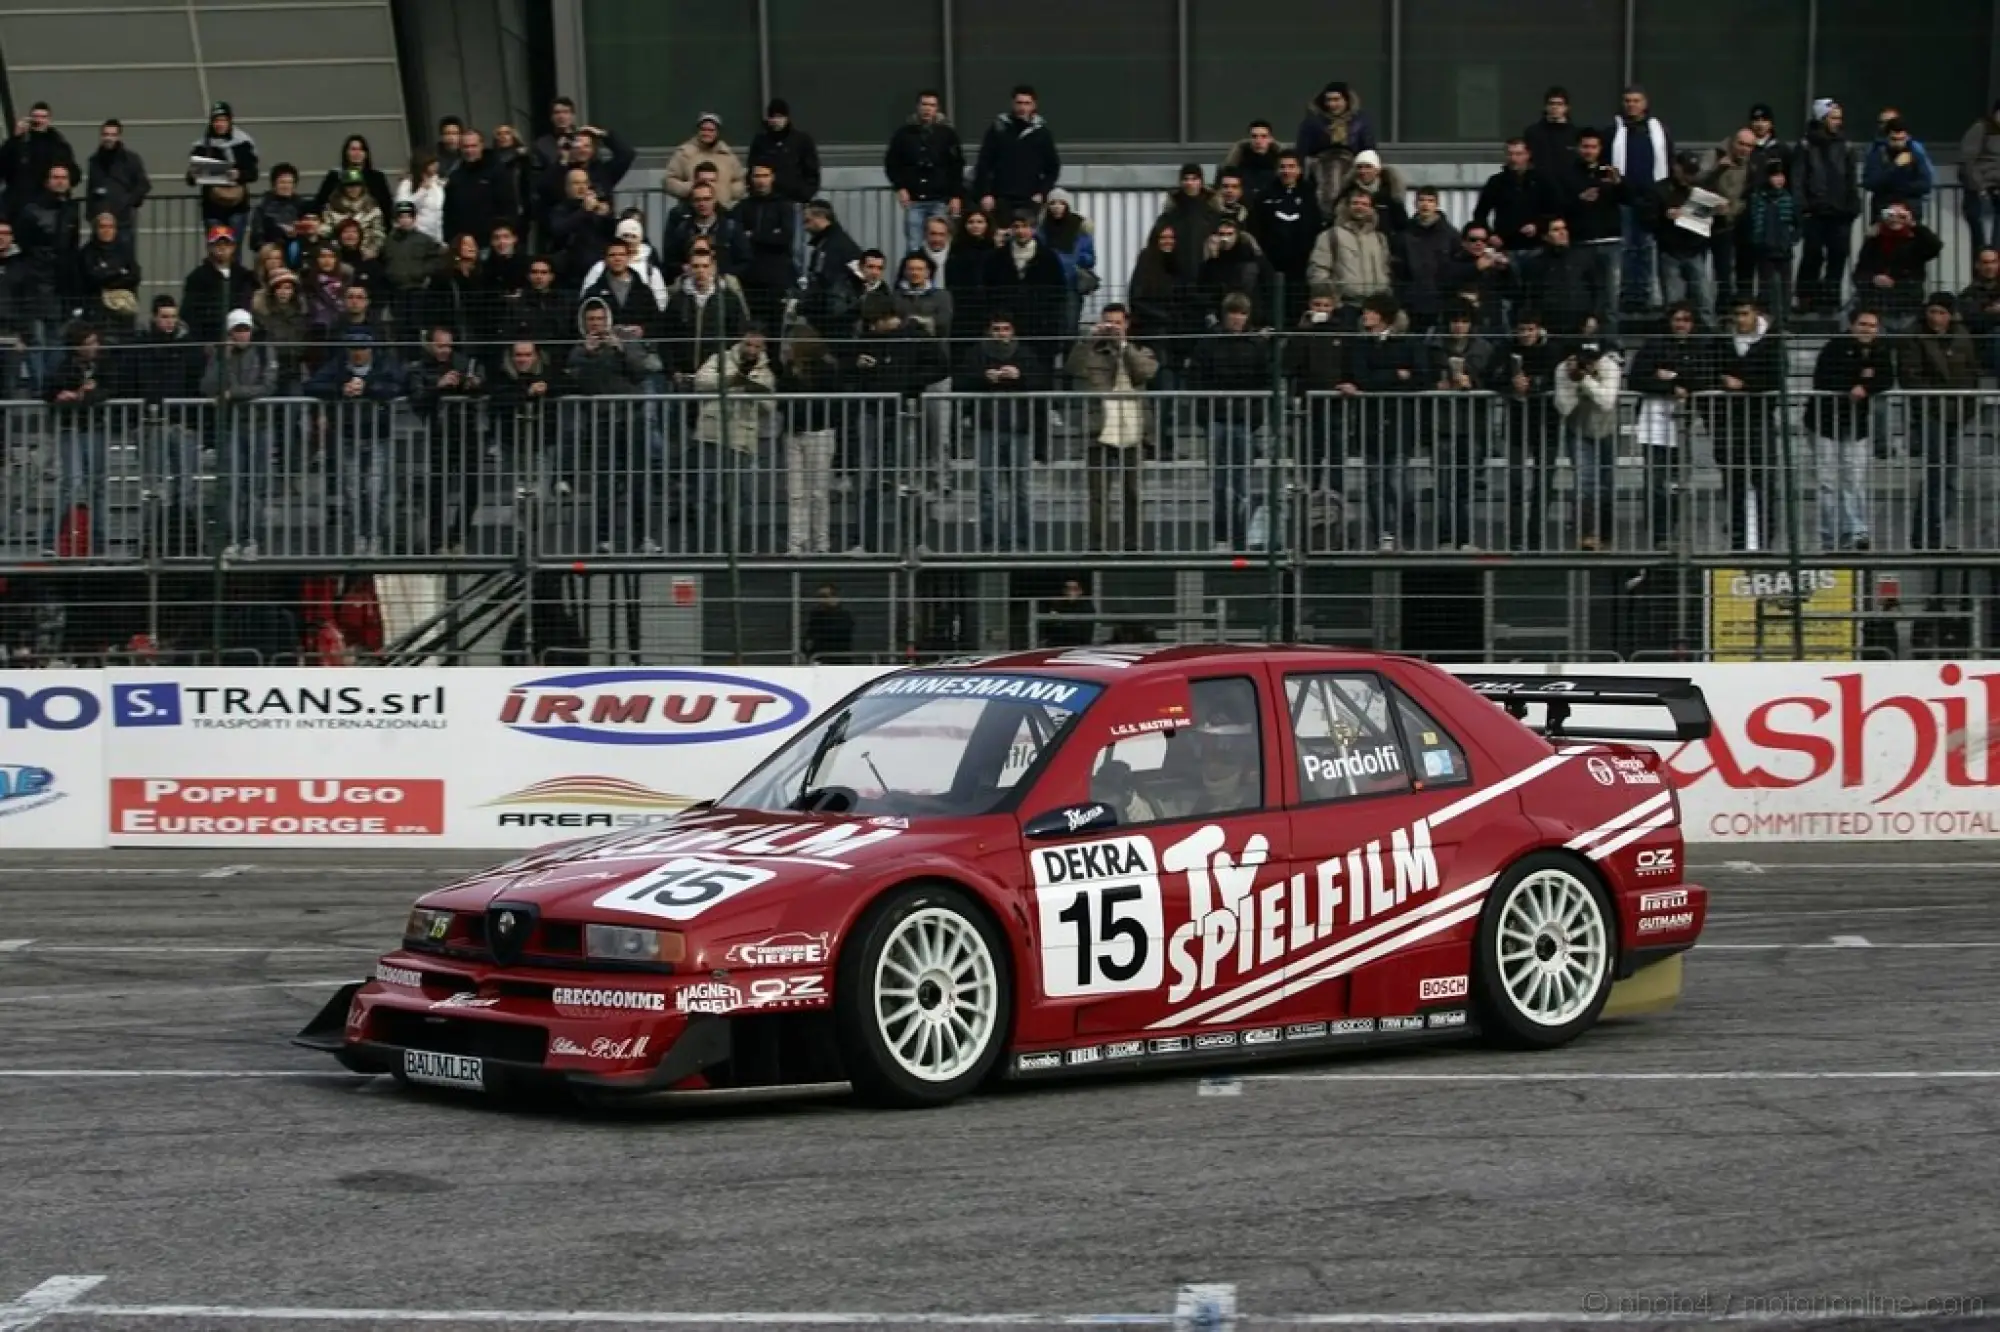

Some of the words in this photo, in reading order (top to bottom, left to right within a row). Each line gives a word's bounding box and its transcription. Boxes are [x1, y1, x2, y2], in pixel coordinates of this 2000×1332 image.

[193, 718, 291, 730] TRASPORTI
[296, 718, 448, 730] INTERNAZIONALI
[1302, 744, 1401, 782] Pandolfi
[1710, 811, 1874, 835] COMMITTED
[1878, 811, 1915, 835] TO
[1919, 810, 2000, 835] TOTAL
[1043, 841, 1149, 884] DEKRA
[1162, 824, 1269, 936] TV
[627, 868, 754, 906] 15
[1168, 818, 1440, 1004] SPIELFILM
[1059, 884, 1149, 986] 15
[552, 987, 665, 1011] GRECOGOMME
[1423, 978, 1466, 996] BOSCH
